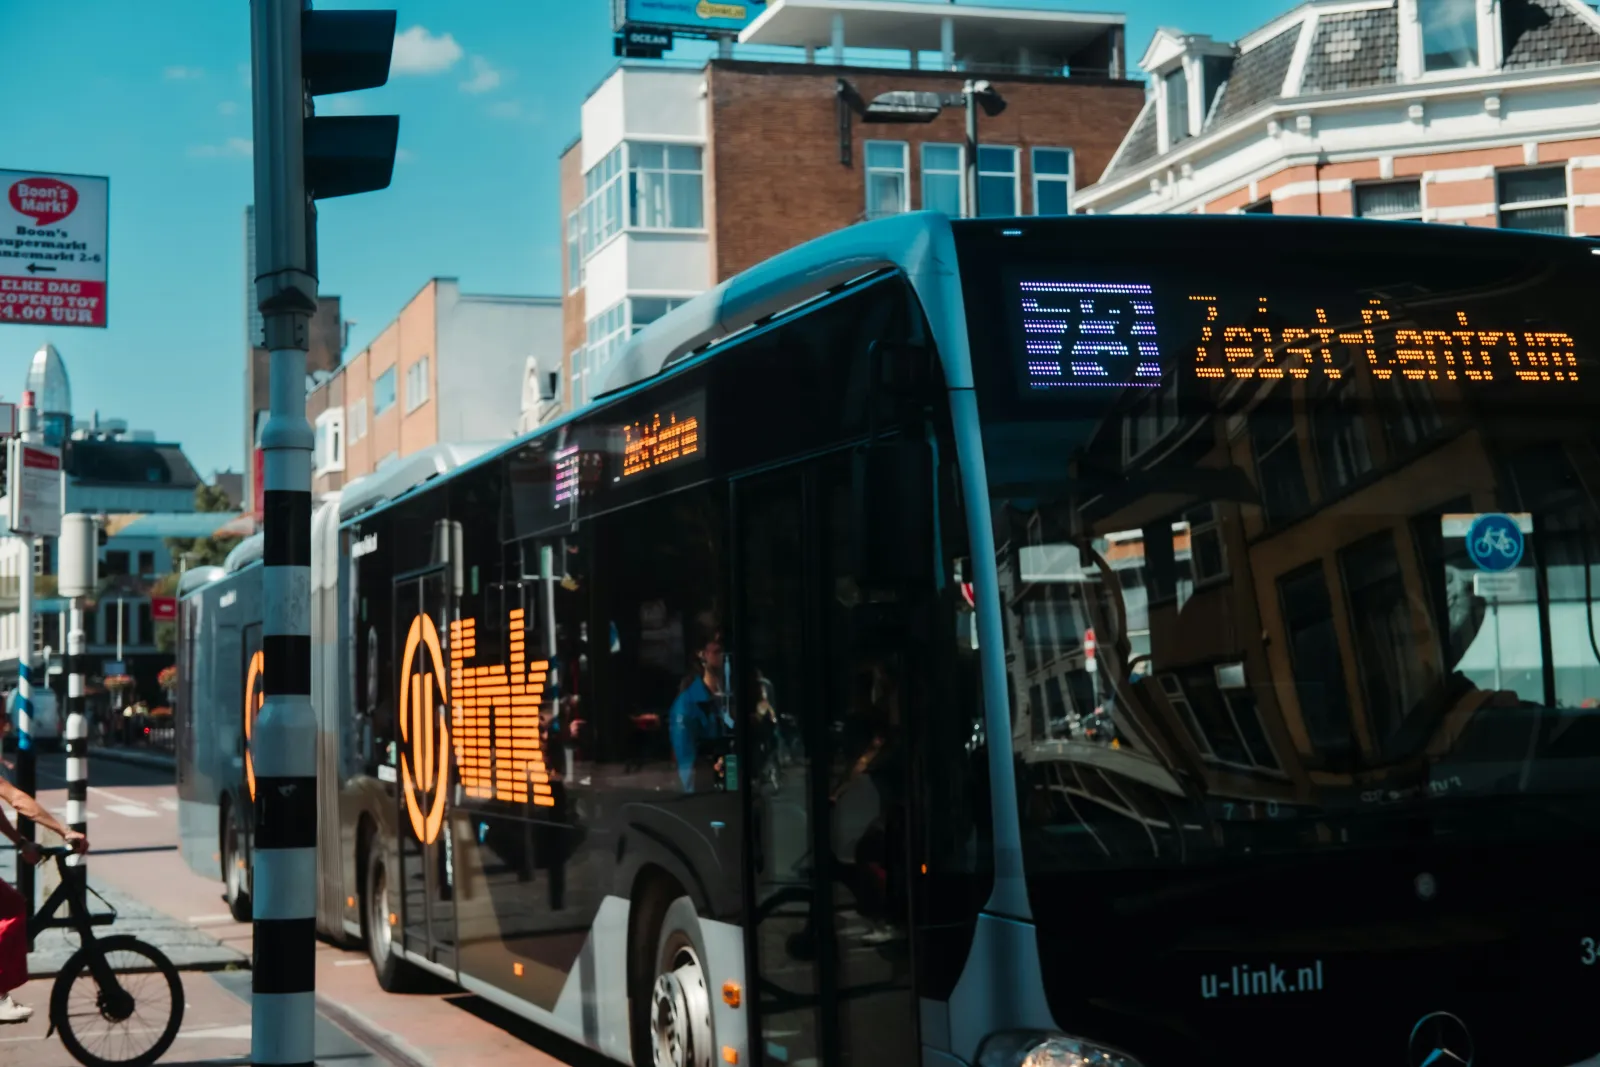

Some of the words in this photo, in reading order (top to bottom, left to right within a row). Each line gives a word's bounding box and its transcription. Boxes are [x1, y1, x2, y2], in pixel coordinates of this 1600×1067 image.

[630, 33, 668, 44] OCEAN
[17, 183, 69, 200] Boon's
[20, 198, 68, 213] Markt
[16, 225, 68, 238] Boon's
[1, 279, 44, 293] ELKE
[48, 282, 81, 294] DAG
[66, 297, 99, 308] TOT
[0, 304, 47, 320] 4.00
[51, 307, 93, 323] UUR
[1189, 296, 1578, 381] Zeist-Centrum
[1200, 960, 1324, 999] u-link.nl
